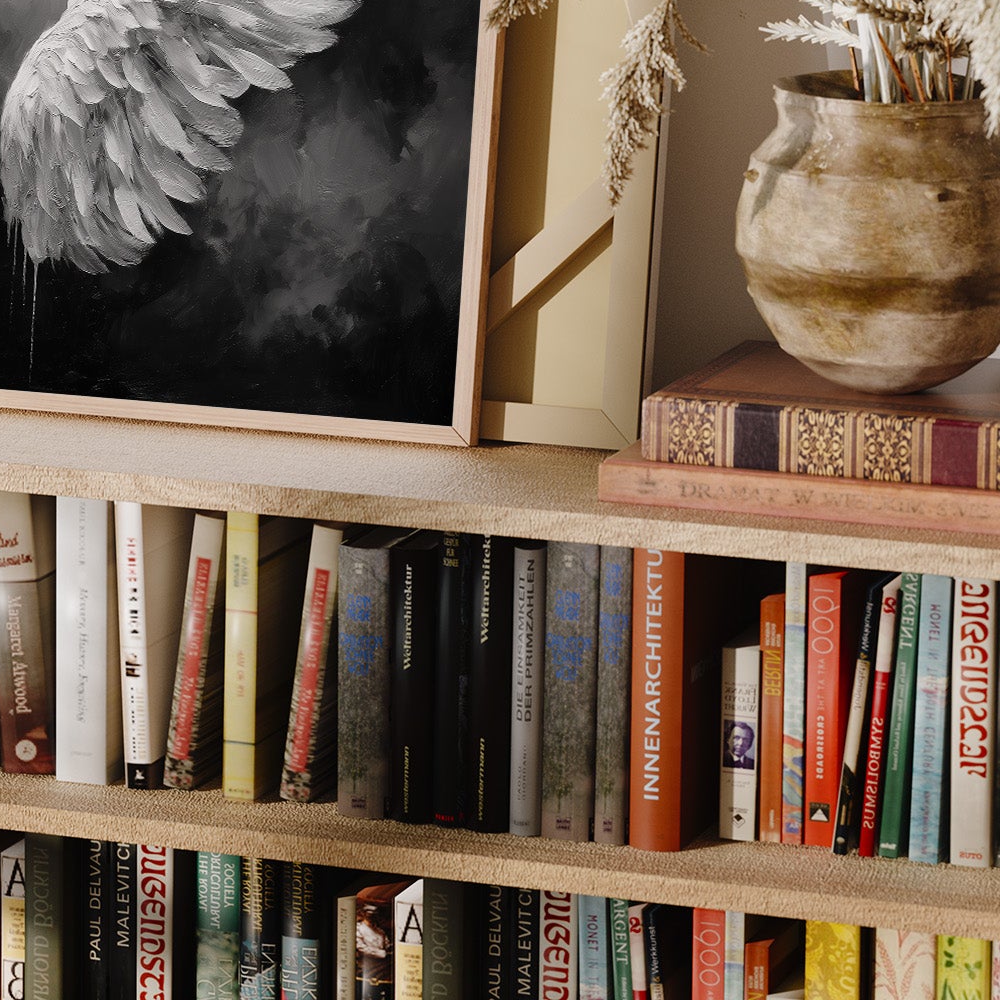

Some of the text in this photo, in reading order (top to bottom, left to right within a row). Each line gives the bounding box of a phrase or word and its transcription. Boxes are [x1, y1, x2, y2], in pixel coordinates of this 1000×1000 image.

[679, 482, 814, 504] DRAMAT W
[6, 595, 32, 714] Margaret Atwood
[402, 563, 412, 671] Weltarchitektur
[516, 574, 525, 721] DIE EINSAMKEIT
[524, 559, 534, 722] DER PRIMZAHLEN
[643, 549, 662, 800] INNENARCHITEKTU
[402, 745, 410, 814] westermann
[477, 737, 485, 822] westermann
[89, 840, 101, 961] PAUL DELVAU
[488, 885, 502, 956] DELVAU
[587, 914, 598, 950] MONET
[613, 898, 628, 965] ARGENT
[648, 925, 660, 974] Werkkunst
[694, 921, 720, 986] 1900
